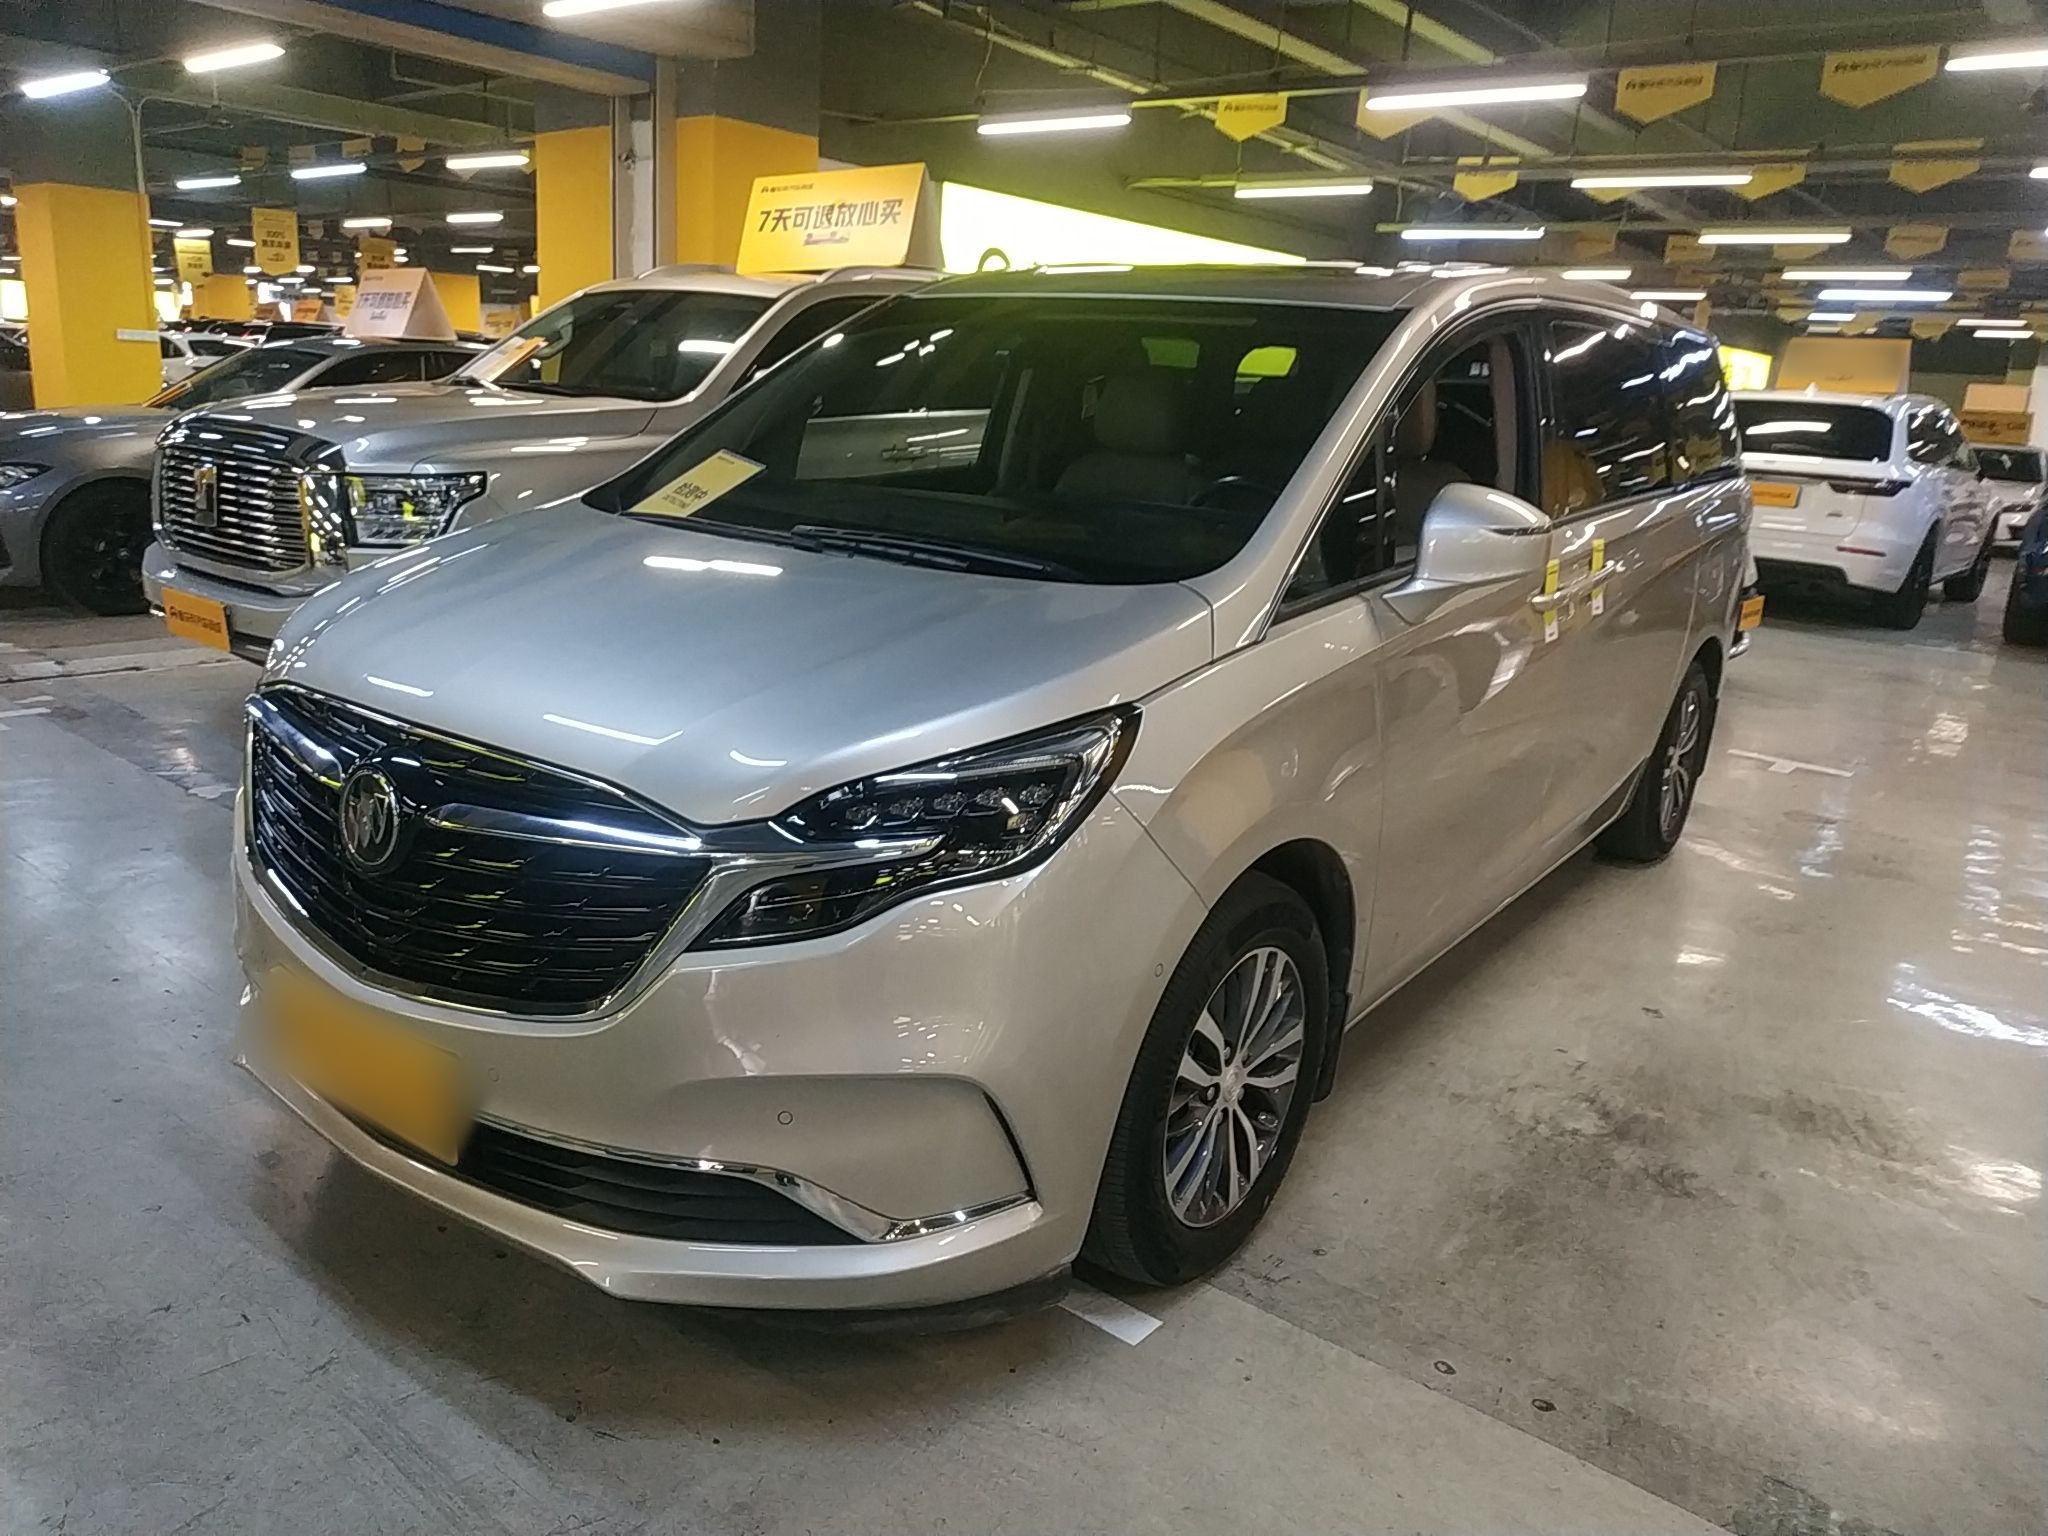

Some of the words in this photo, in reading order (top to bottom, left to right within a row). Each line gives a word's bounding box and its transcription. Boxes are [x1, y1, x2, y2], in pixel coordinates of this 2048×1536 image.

[758, 198, 904, 233] 7天可退放心买
